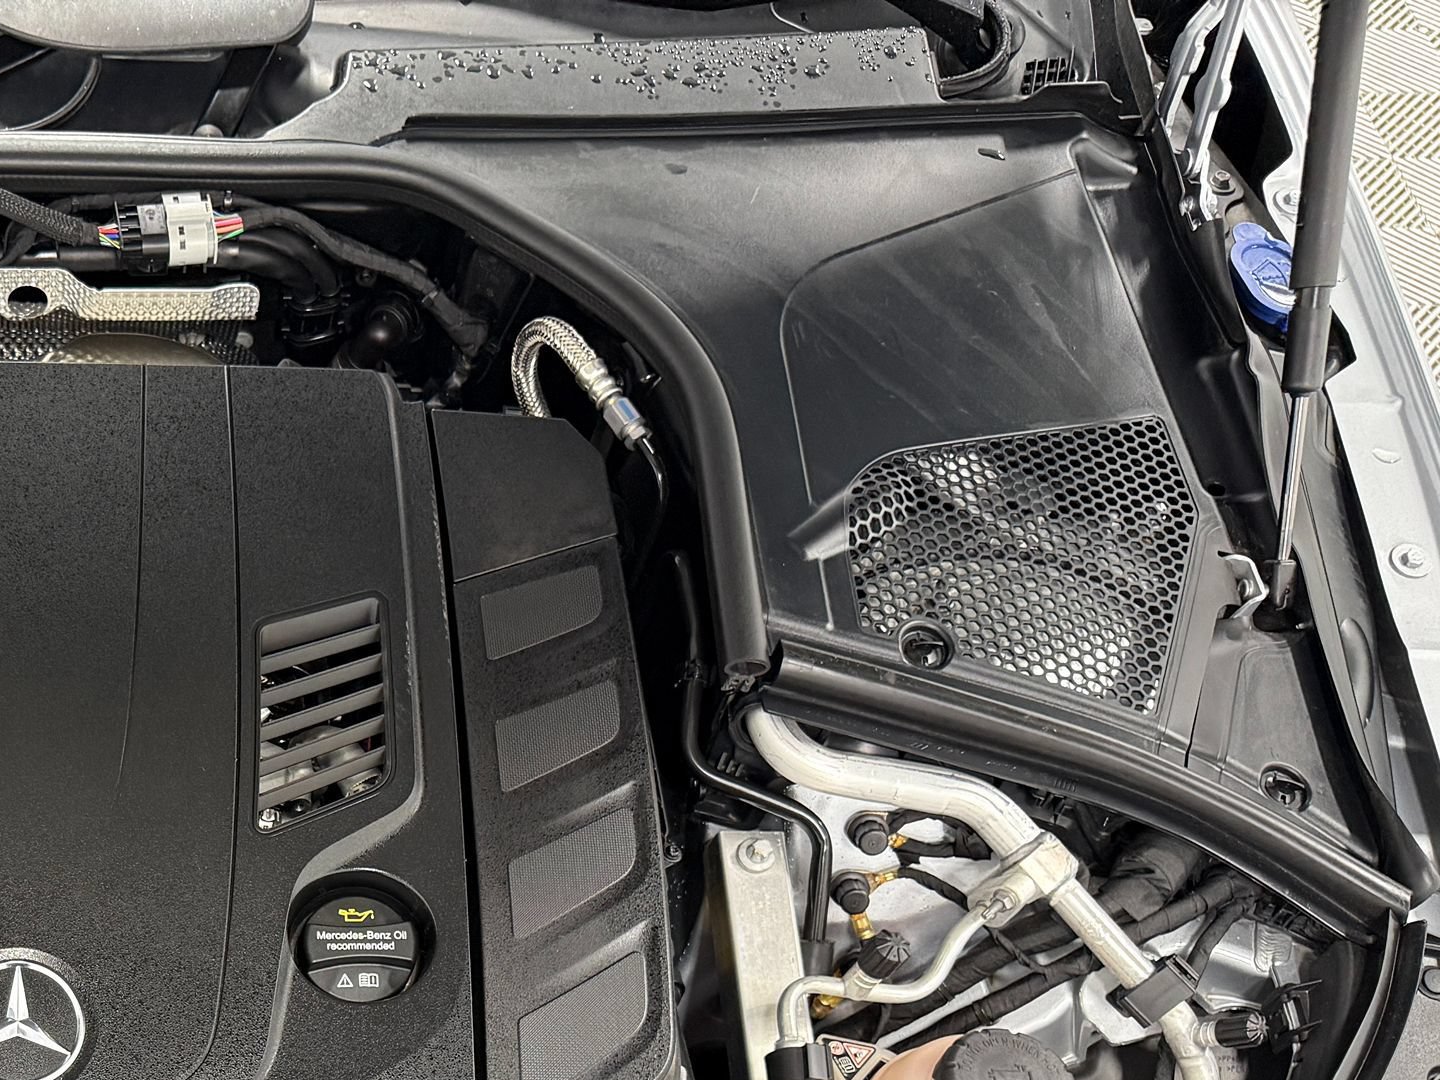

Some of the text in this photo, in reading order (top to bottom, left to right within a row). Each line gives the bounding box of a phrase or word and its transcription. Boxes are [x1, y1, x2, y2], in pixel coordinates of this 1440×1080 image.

[316, 930, 407, 940] Mercedes-Benz Oil
[326, 941, 395, 951] recommended
